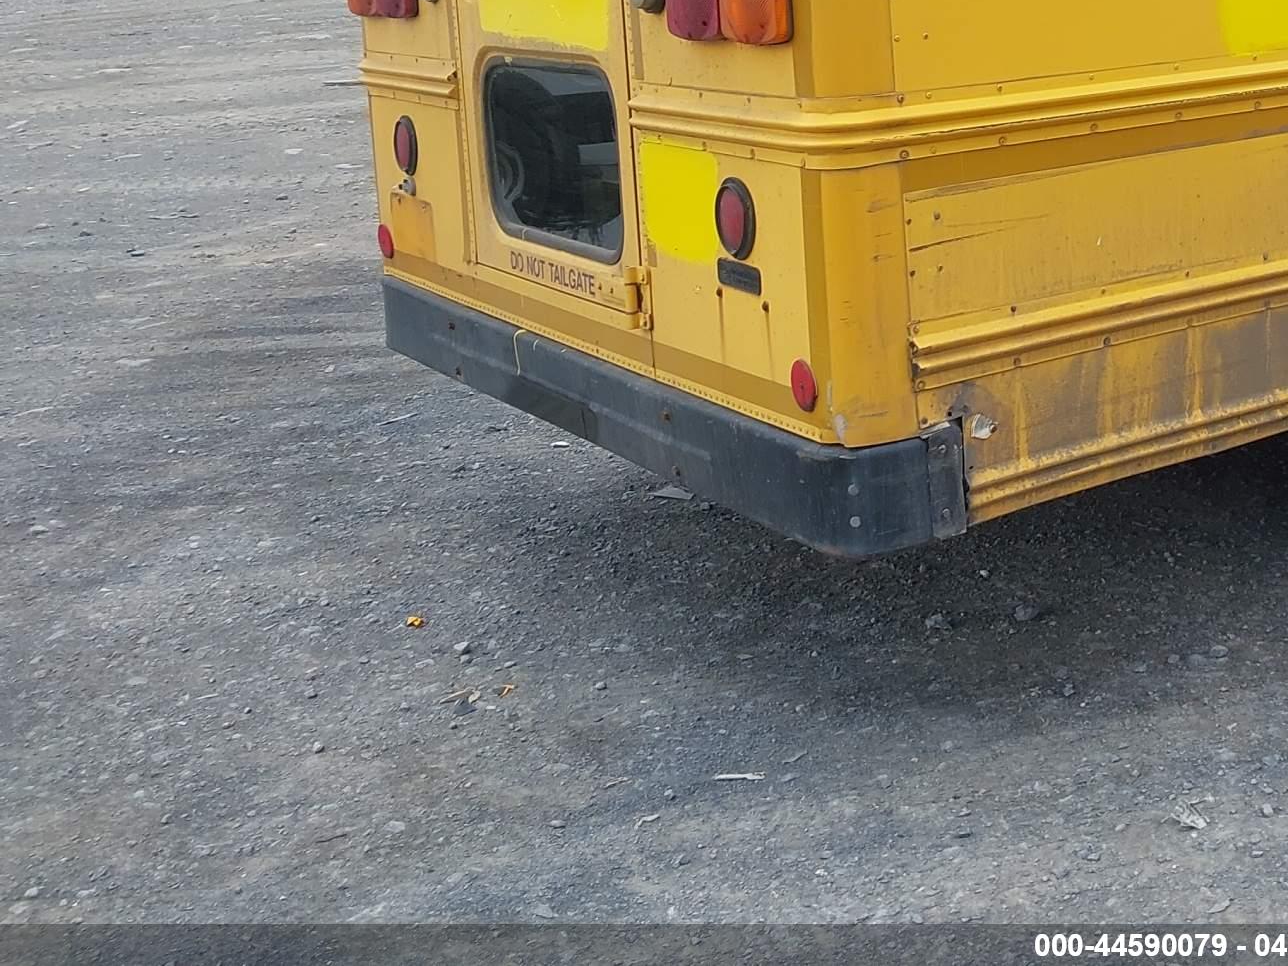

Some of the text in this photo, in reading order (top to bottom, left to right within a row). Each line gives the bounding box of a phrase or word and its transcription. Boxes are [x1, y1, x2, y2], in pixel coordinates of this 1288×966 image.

[510, 251, 596, 297] DO NOT TAILGATE
